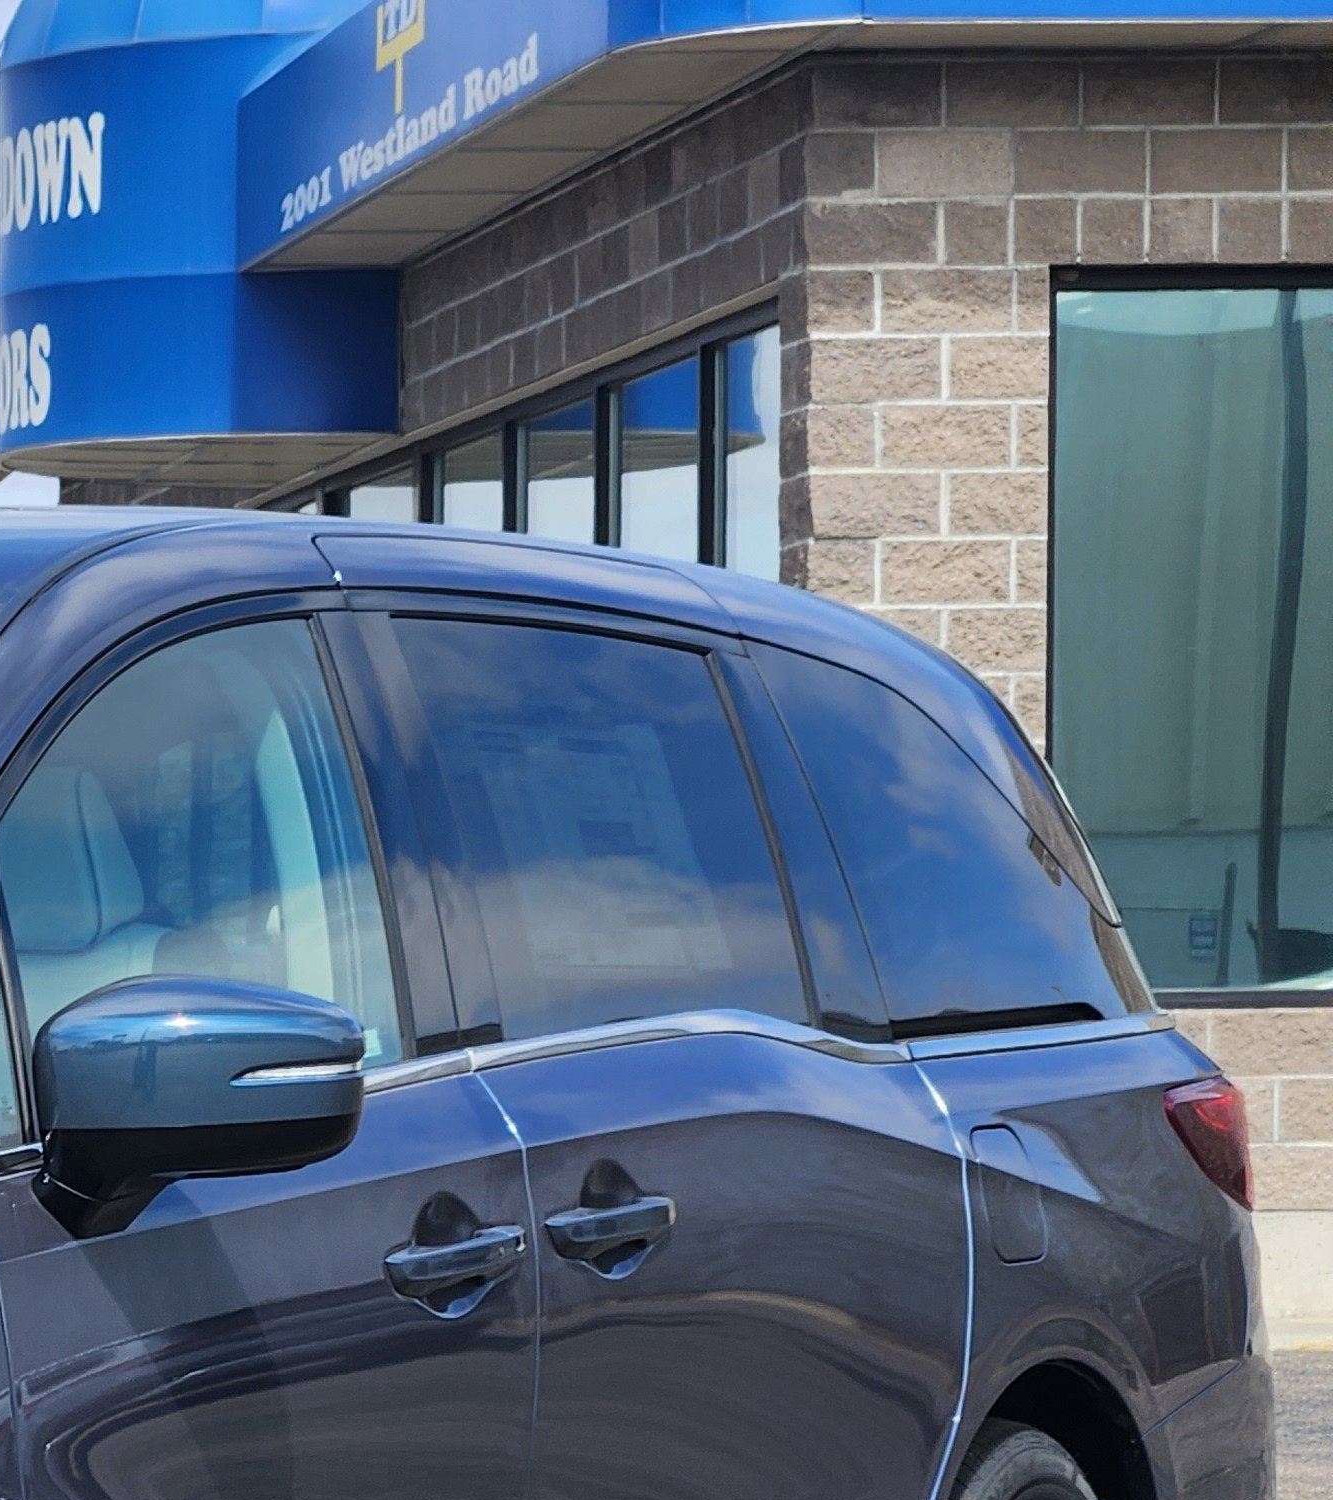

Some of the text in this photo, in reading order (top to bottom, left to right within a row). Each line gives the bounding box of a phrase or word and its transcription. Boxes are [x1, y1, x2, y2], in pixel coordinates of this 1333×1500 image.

[280, 31, 539, 233] 2001 Westland Road
